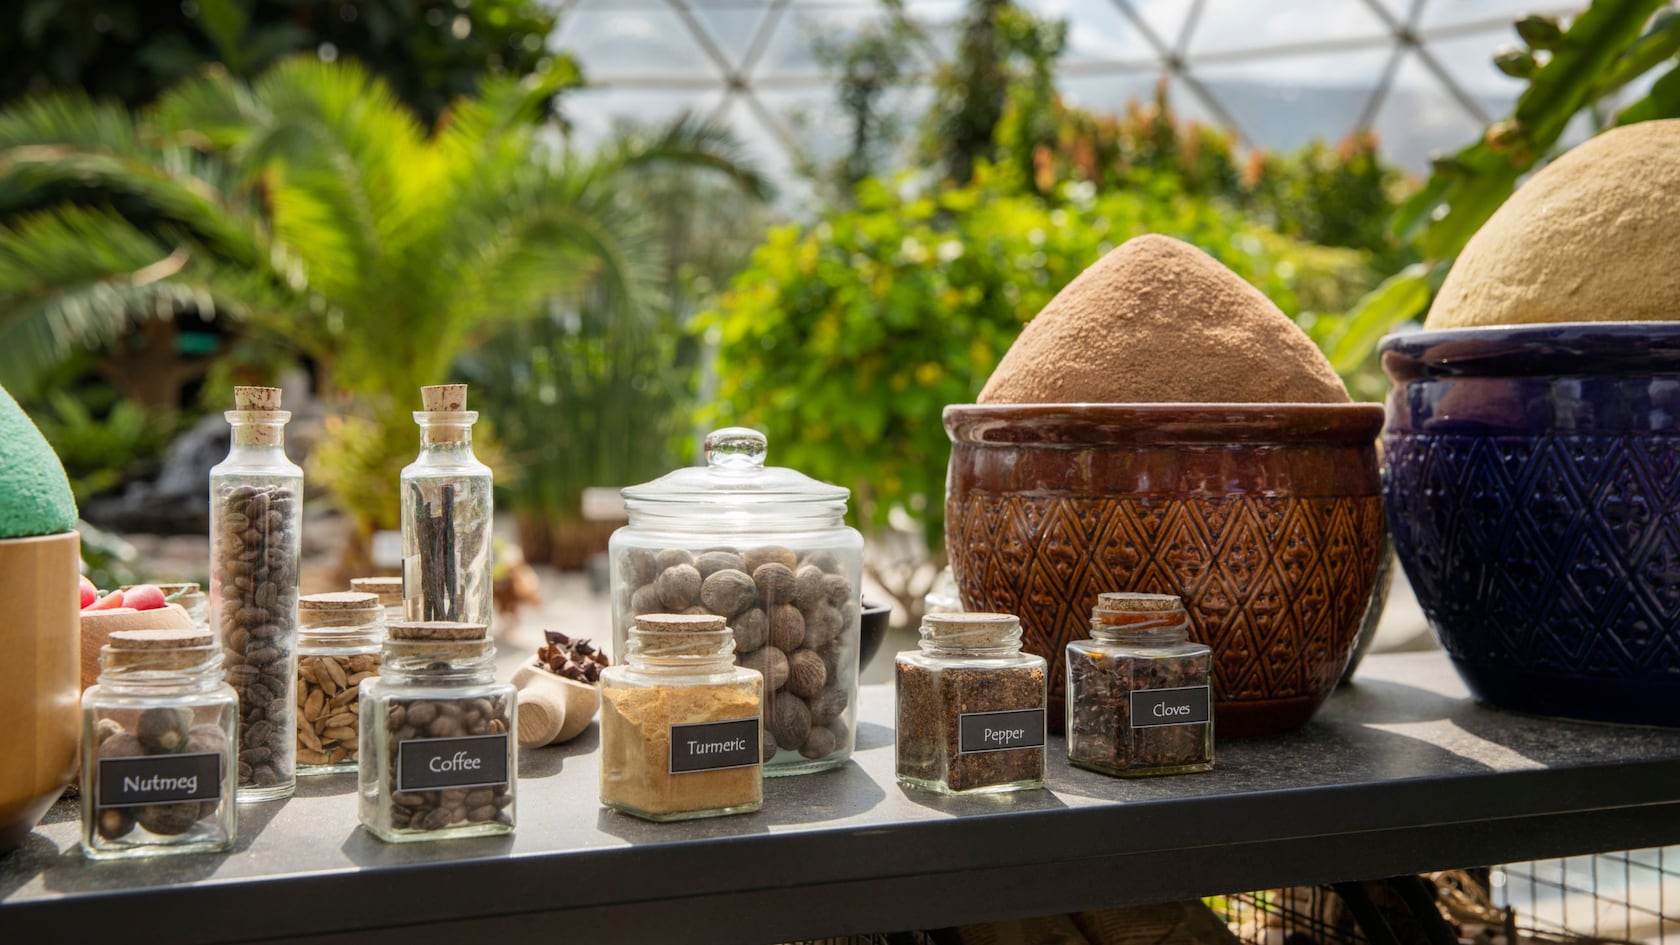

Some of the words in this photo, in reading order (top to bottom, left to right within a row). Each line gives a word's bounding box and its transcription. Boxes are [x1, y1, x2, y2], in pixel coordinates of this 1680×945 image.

[1152, 701, 1190, 717] Cloves
[984, 728, 1025, 744] Pepper
[687, 737, 746, 755] Turmeric
[429, 751, 481, 772] Coffee
[123, 774, 198, 794] Nutmeg
